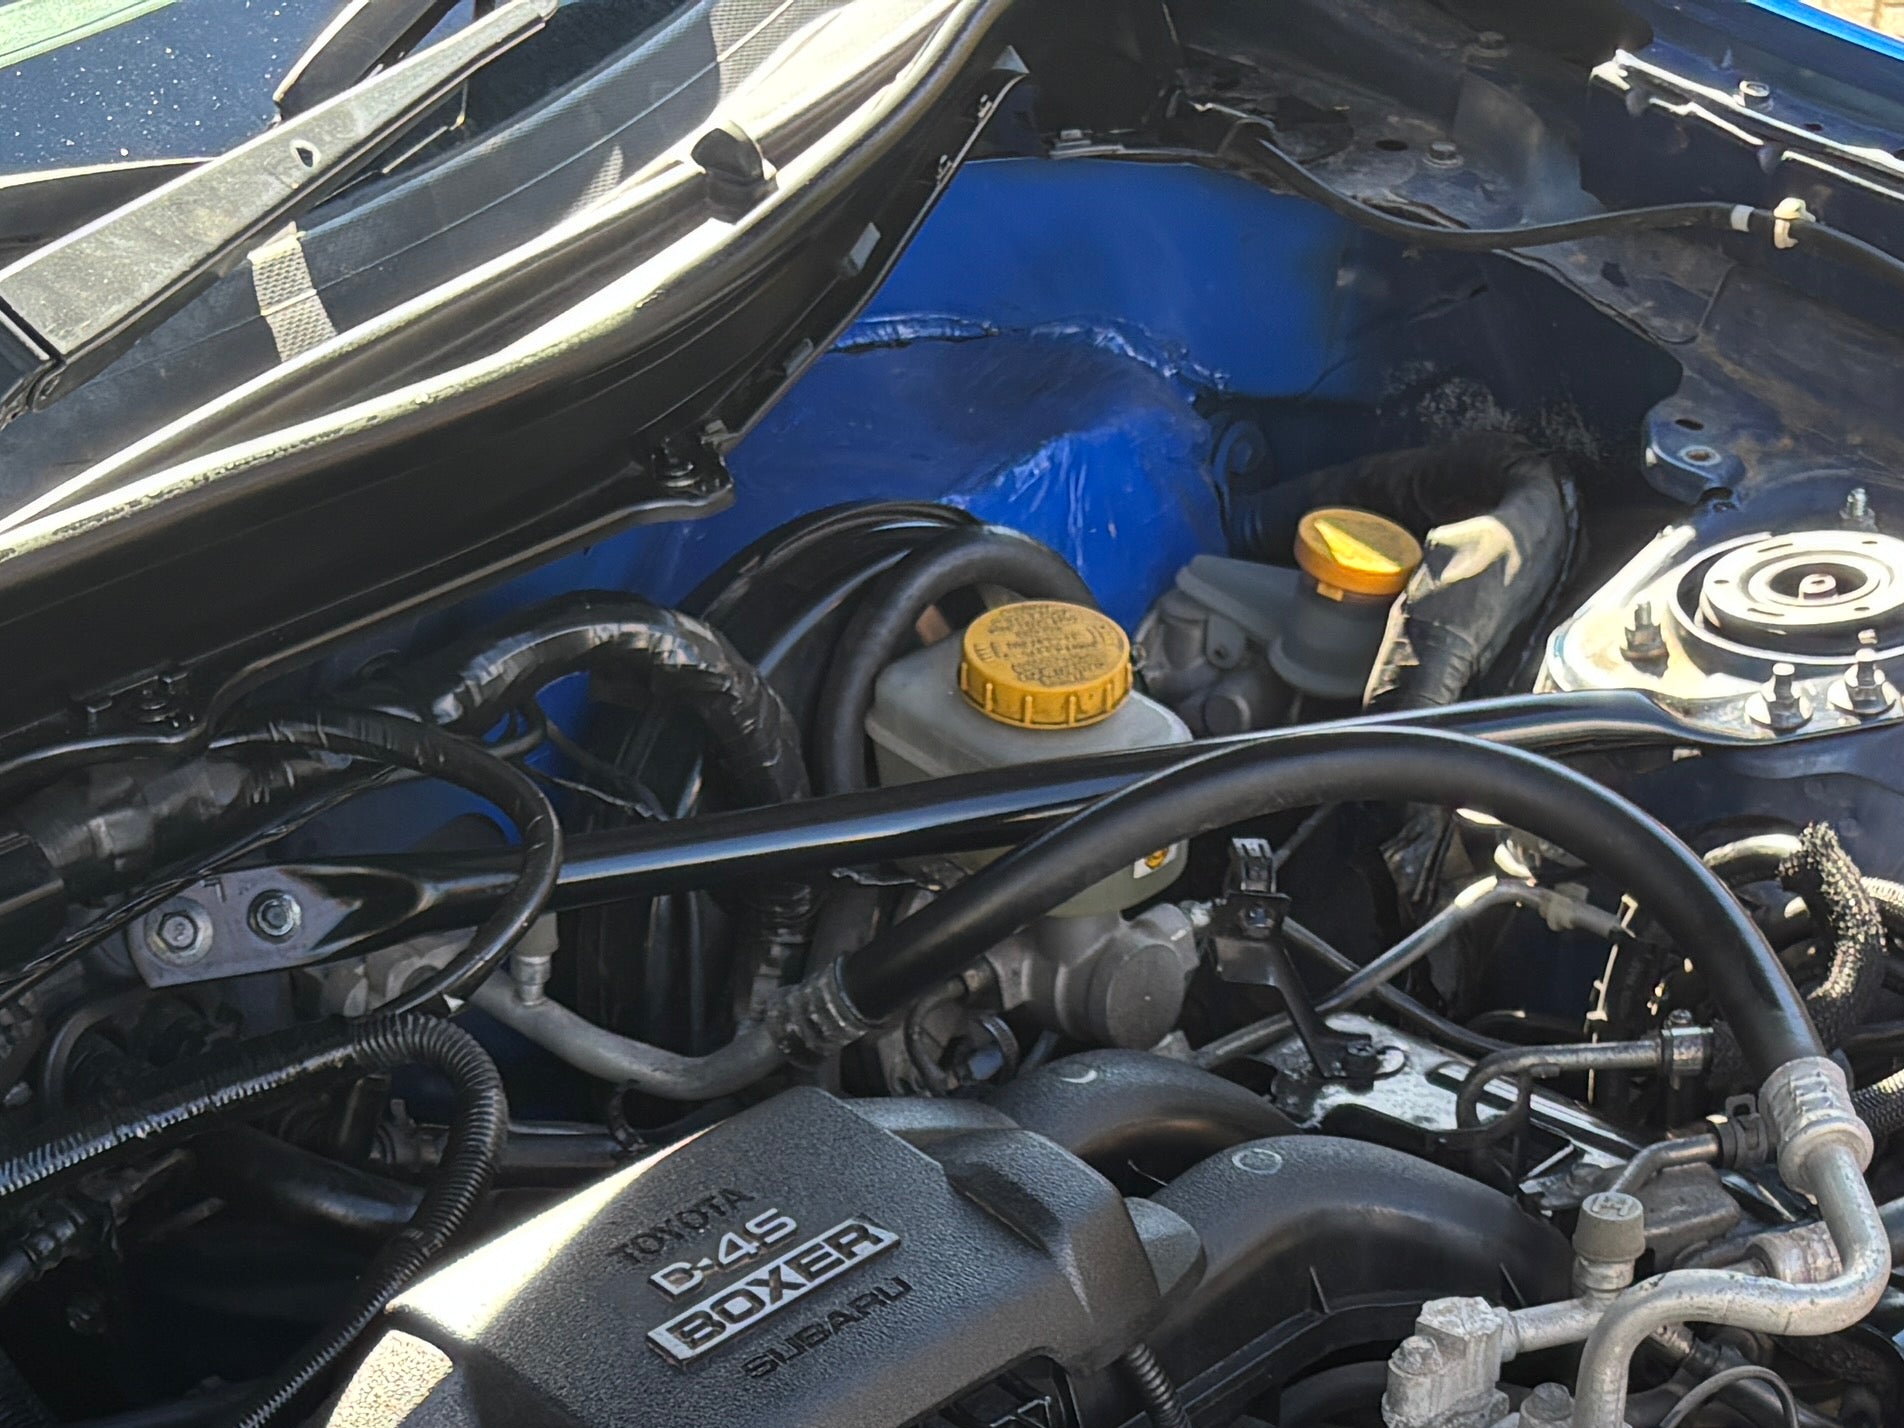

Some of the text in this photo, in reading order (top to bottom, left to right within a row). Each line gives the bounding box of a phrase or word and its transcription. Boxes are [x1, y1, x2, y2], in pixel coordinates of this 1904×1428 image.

[618, 1188, 755, 1264] TOYOTA
[648, 1207, 798, 1299] D-4S
[664, 1222, 885, 1351] BOXER
[741, 1276, 914, 1378] SUBARU
